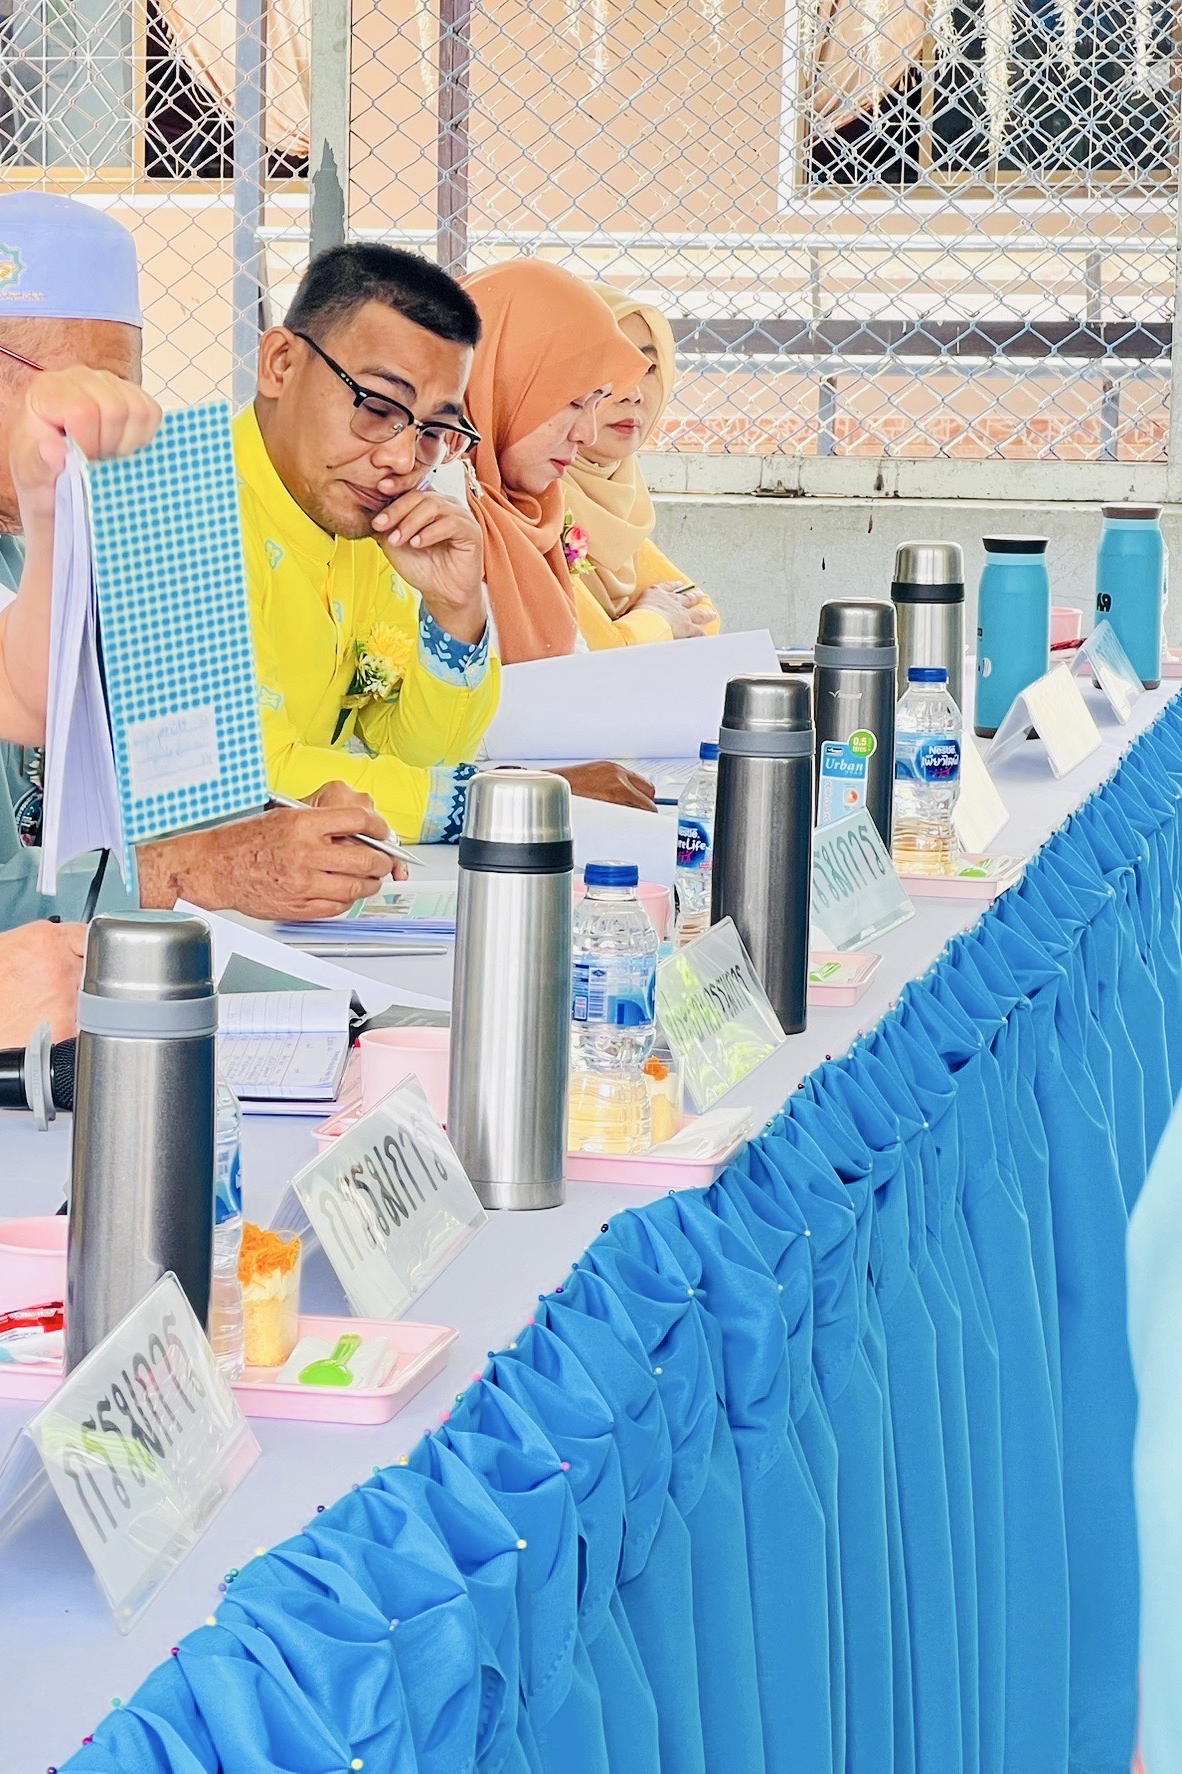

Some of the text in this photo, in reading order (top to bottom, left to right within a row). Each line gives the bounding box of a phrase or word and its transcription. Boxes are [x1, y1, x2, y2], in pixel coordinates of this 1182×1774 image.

[853, 738, 867, 746] 0.5
[825, 758, 864, 771] Urban
[64, 1310, 206, 1544] กรรมการ
